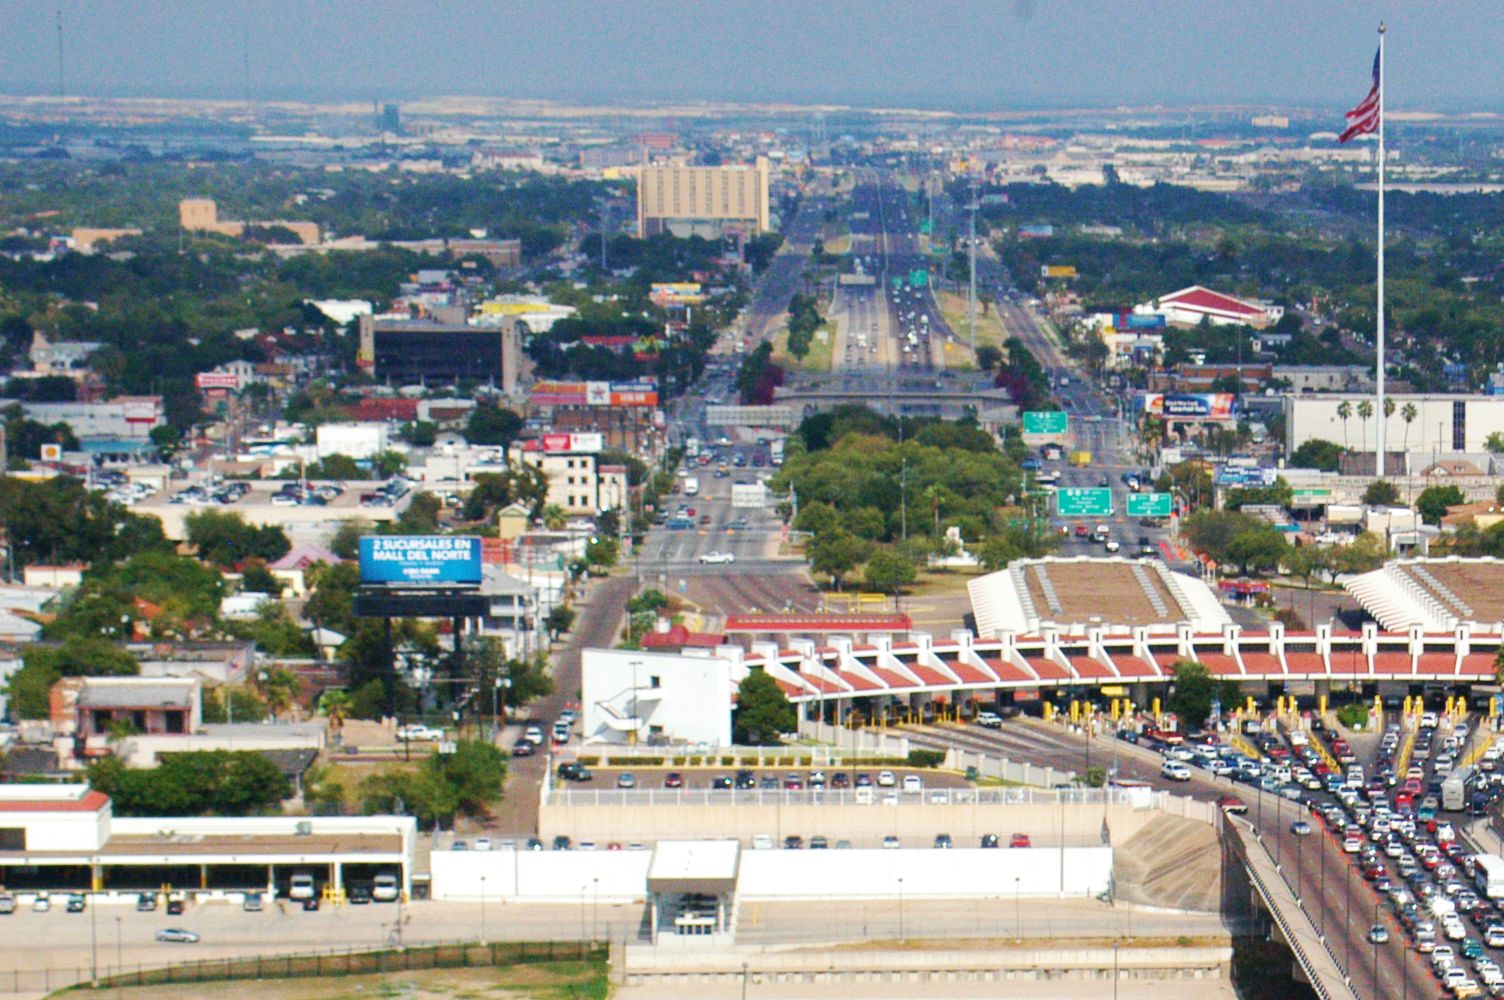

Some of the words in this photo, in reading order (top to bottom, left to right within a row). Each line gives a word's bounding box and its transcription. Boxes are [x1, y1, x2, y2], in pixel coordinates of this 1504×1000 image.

[373, 540, 380, 550] 2
[382, 540, 452, 550] SUCURSALES
[454, 539, 471, 550] EN
[373, 550, 405, 560] MALL
[407, 550, 429, 560] DEL
[431, 550, 471, 560] NORTE
